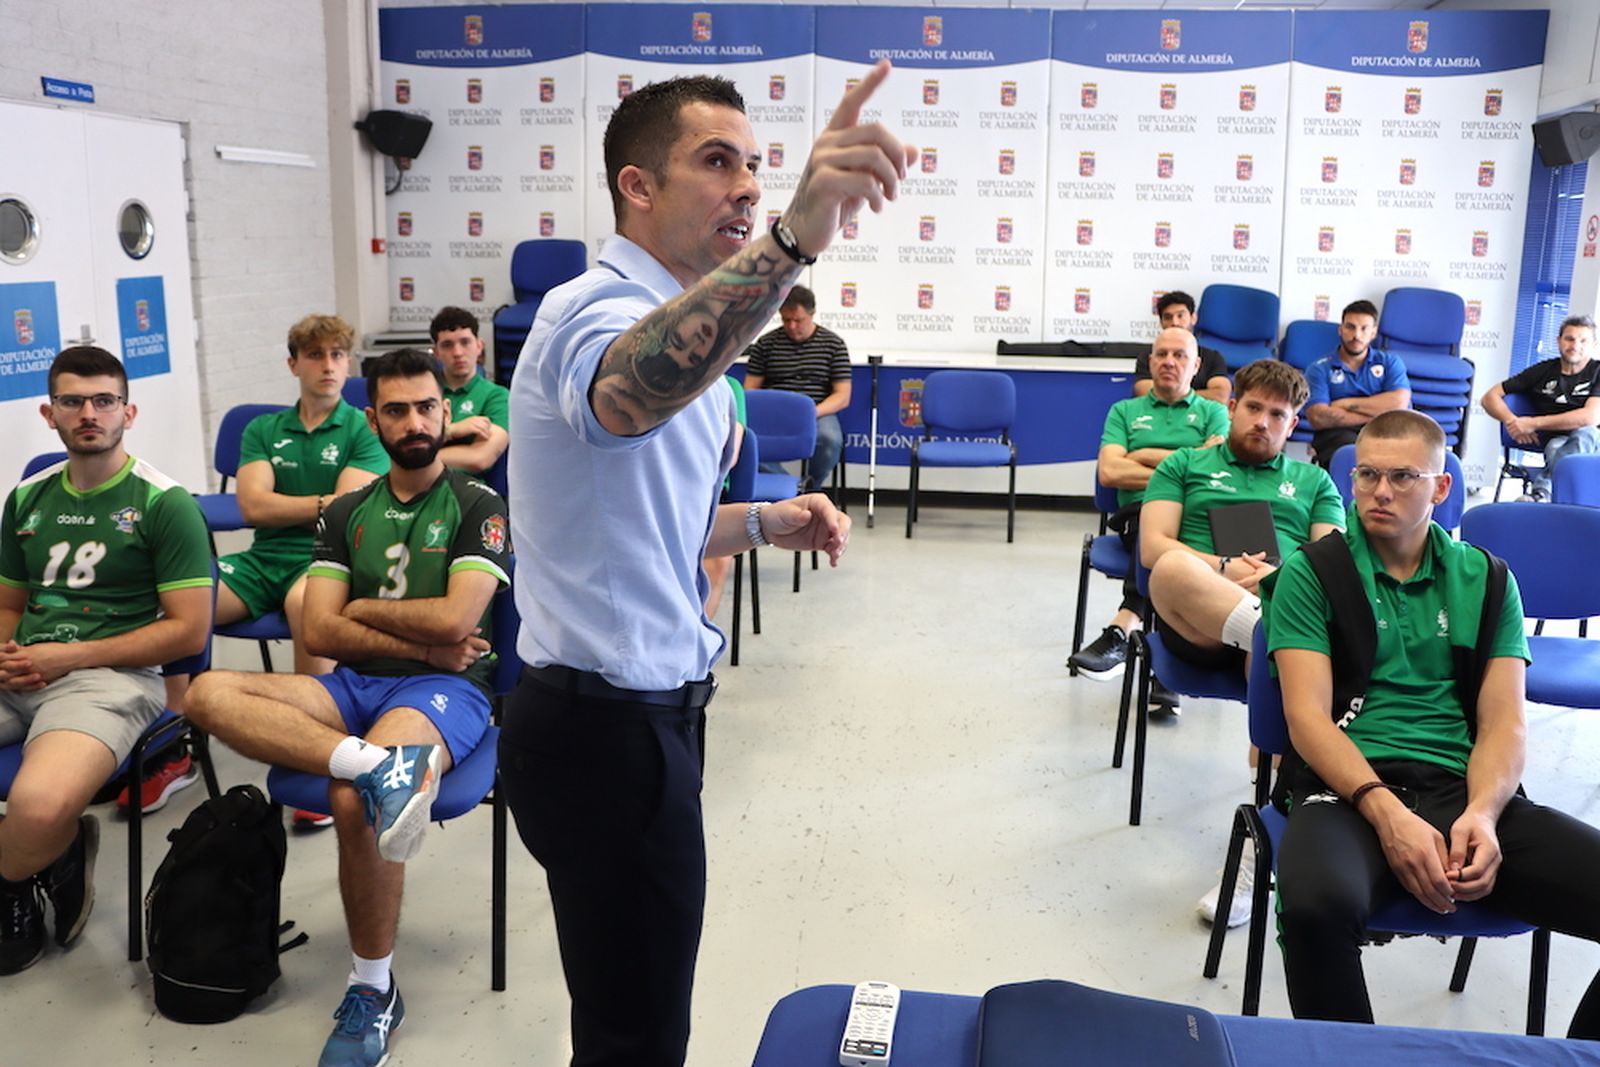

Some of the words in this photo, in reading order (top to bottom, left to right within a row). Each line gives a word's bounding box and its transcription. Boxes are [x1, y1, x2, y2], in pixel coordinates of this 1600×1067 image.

[416, 49, 474, 59] DIPUTACIÓN
[476, 49, 489, 59] DE
[491, 47, 533, 58] ALMERÍA
[640, 44, 700, 55] DIPUTACIÓN
[704, 46, 717, 55] DE
[719, 44, 763, 55] ALMERÍA
[869, 48, 932, 59] DIPUTACIÓN
[934, 50, 948, 60] DE
[950, 49, 994, 60] ALMERÍA
[1106, 52, 1170, 63] DIPUTACIÓN
[1172, 54, 1186, 64] DE
[1188, 53, 1234, 64] ALMERÍA
[1352, 55, 1416, 66] DIPUTACIÓN
[1418, 57, 1432, 66] DE
[1434, 56, 1480, 67] ALMERÍA
[1462, 131, 1474, 139] DE
[521, 184, 532, 192] DE
[901, 188, 912, 196] DE
[831, 244, 878, 253] PUTACIÓN
[822, 254, 833, 262] DE
[1056, 259, 1068, 267] DE
[1134, 261, 1146, 269] DE
[1212, 264, 1224, 272] DE
[1054, 327, 1066, 336] DE
[126, 348, 135, 359] DE
[1, 364, 14, 376] DE
[41, 541, 107, 589] 18
[379, 543, 410, 600] 3
